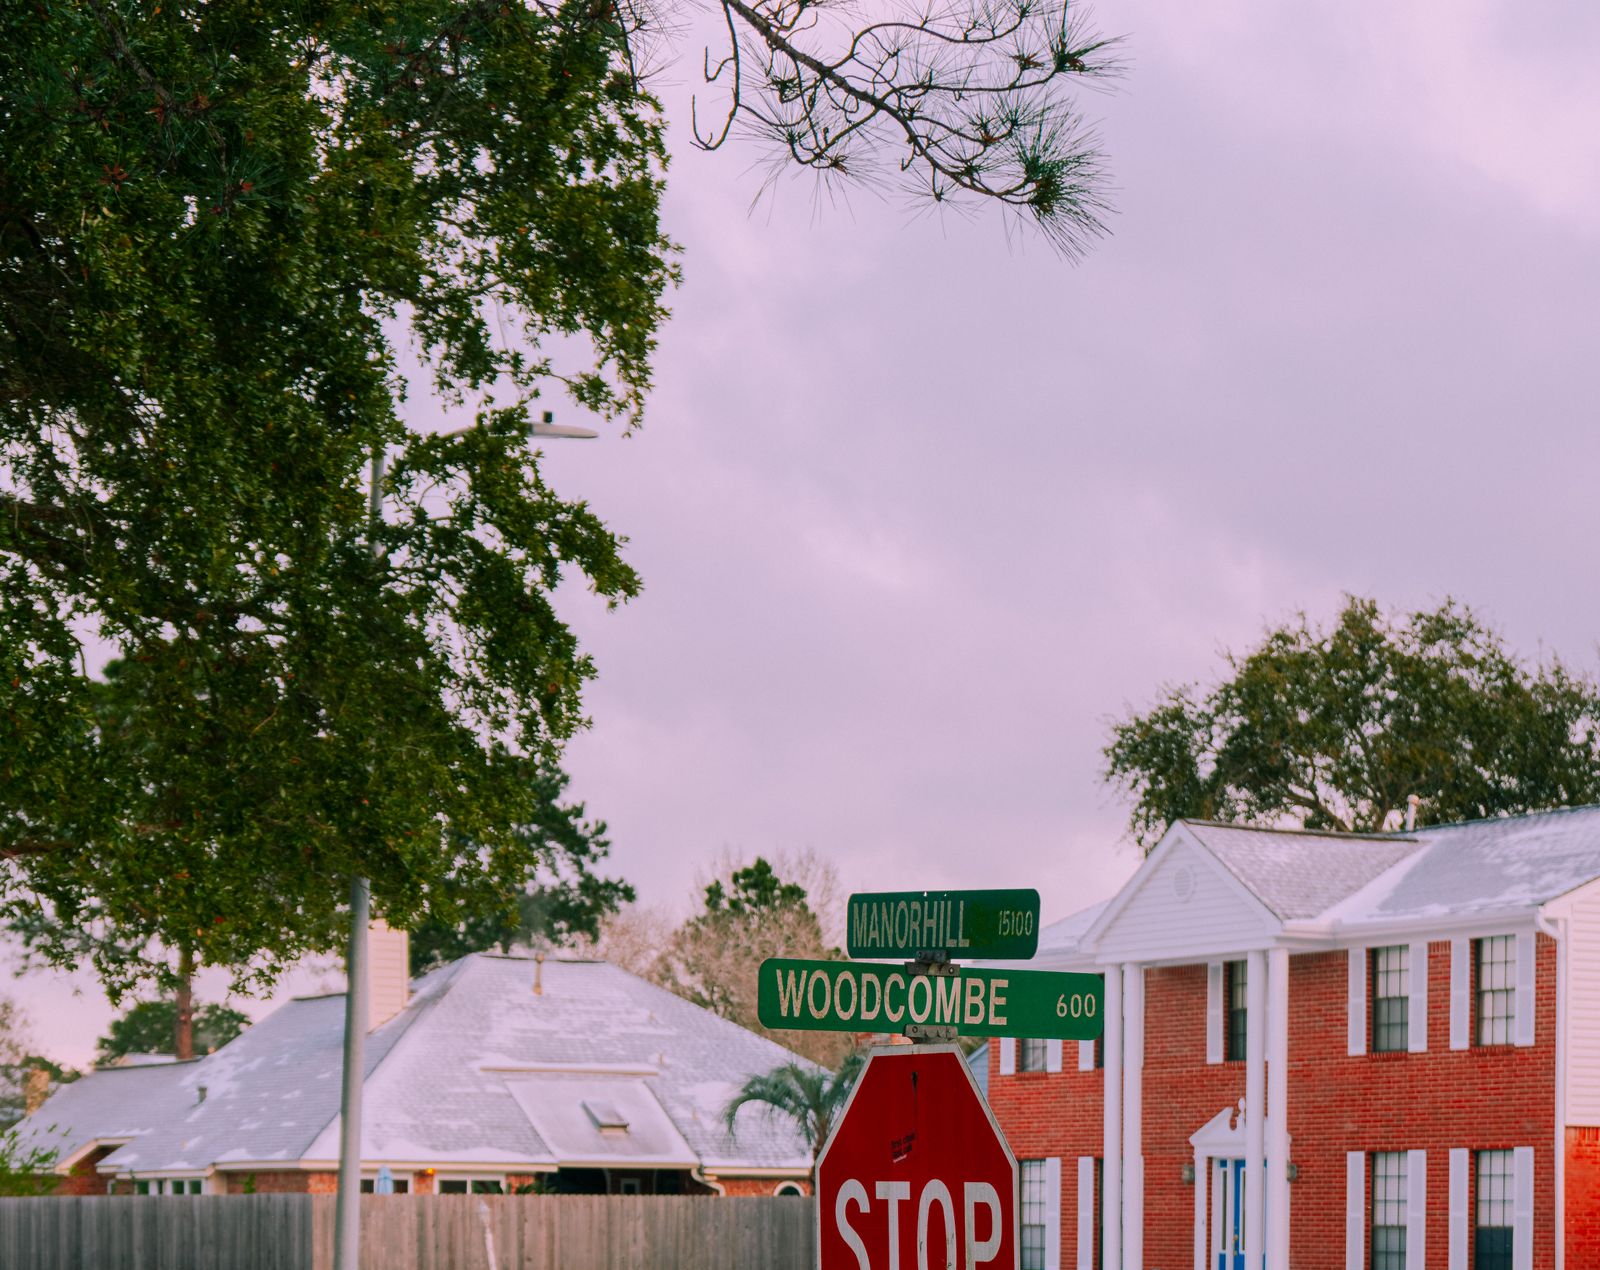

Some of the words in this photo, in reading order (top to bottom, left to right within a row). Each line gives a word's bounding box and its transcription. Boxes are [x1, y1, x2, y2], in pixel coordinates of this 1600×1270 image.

[852, 900, 970, 949] MANORHILL
[998, 910, 1034, 936] 15100
[776, 969, 1009, 1026] WOODCOMBE
[1056, 993, 1096, 1018] 600
